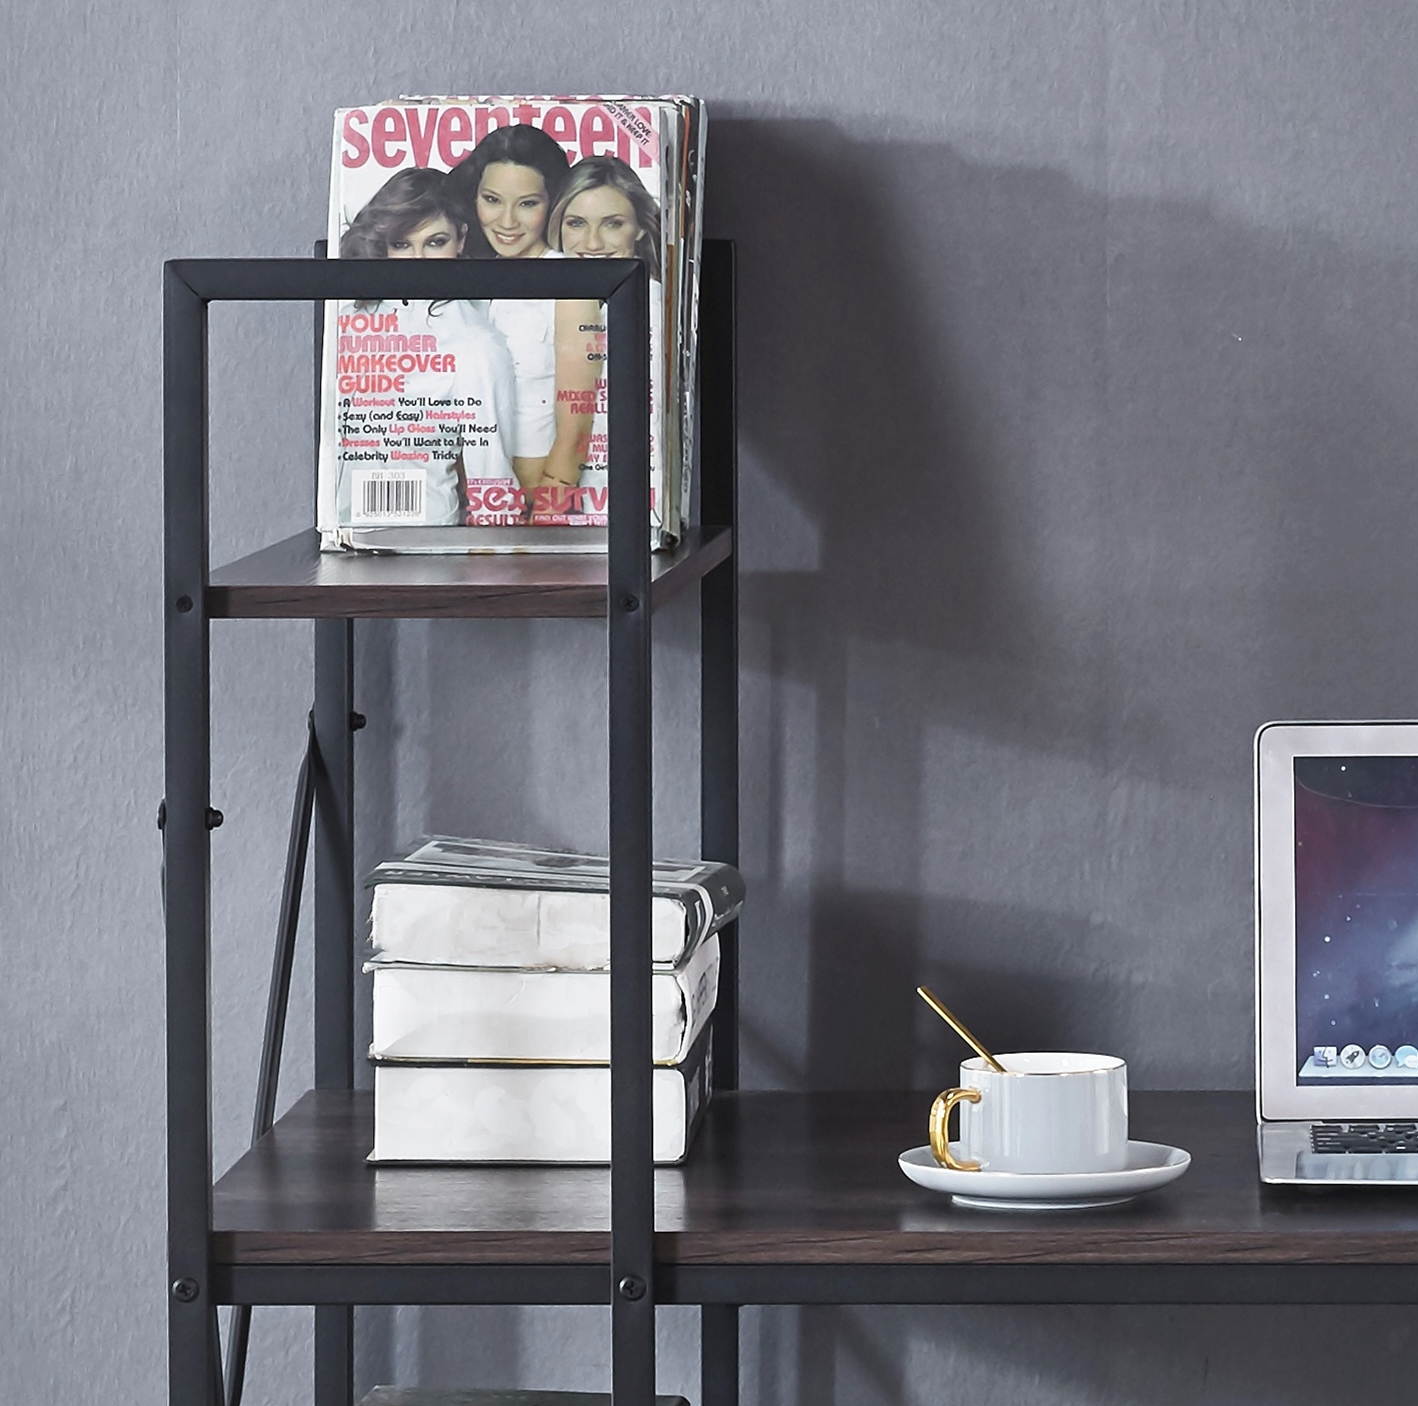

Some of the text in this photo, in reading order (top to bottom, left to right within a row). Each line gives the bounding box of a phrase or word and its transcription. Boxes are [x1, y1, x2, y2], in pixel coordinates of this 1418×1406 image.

[338, 313, 399, 333] YOUR
[339, 335, 437, 353] SUMMER
[338, 354, 456, 373] MAKEOVER
[338, 375, 405, 394] GUIDE
[352, 397, 395, 406] Workout
[398, 397, 425, 407] You'll
[428, 397, 452, 406] Love
[454, 398, 465, 406] to
[467, 397, 482, 406] Do
[369, 410, 394, 421] (and
[425, 410, 476, 422] Hairstyles
[342, 424, 360, 435] The
[363, 424, 387, 436] Only
[438, 424, 466, 433] You'll
[468, 424, 498, 433] Need
[383, 437, 411, 447] You'll
[414, 437, 441, 447] Want
[444, 438, 454, 446] to
[480, 437, 489, 446] In
[343, 451, 388, 463] Celebrity
